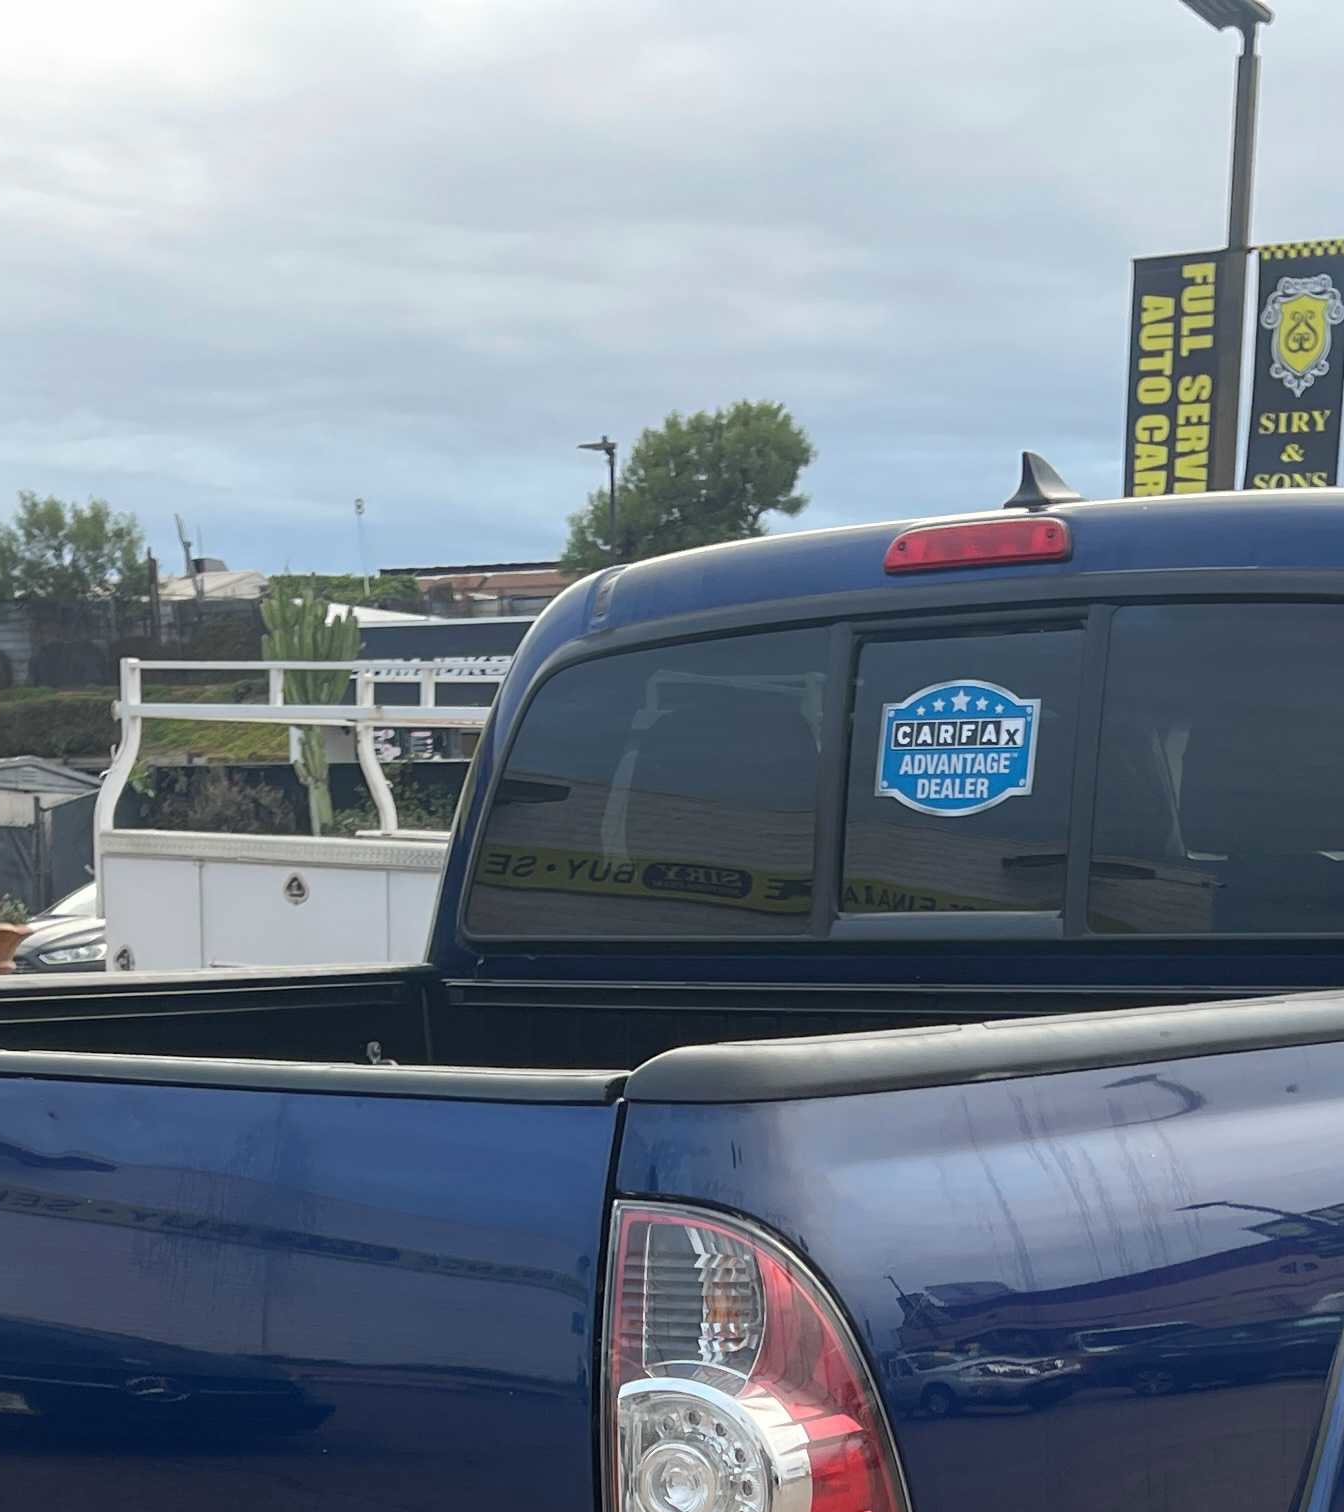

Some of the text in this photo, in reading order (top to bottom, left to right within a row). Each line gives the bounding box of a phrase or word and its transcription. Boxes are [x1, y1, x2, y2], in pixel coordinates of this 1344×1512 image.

[1180, 262, 1216, 357] FULL
[1133, 295, 1175, 497] AUTO CAR
[1258, 410, 1331, 435] SIRY
[1280, 444, 1305, 463] &
[1253, 472, 1328, 490] SONS
[894, 721, 1021, 747] CARFAX
[916, 778, 989, 799] DEALER
